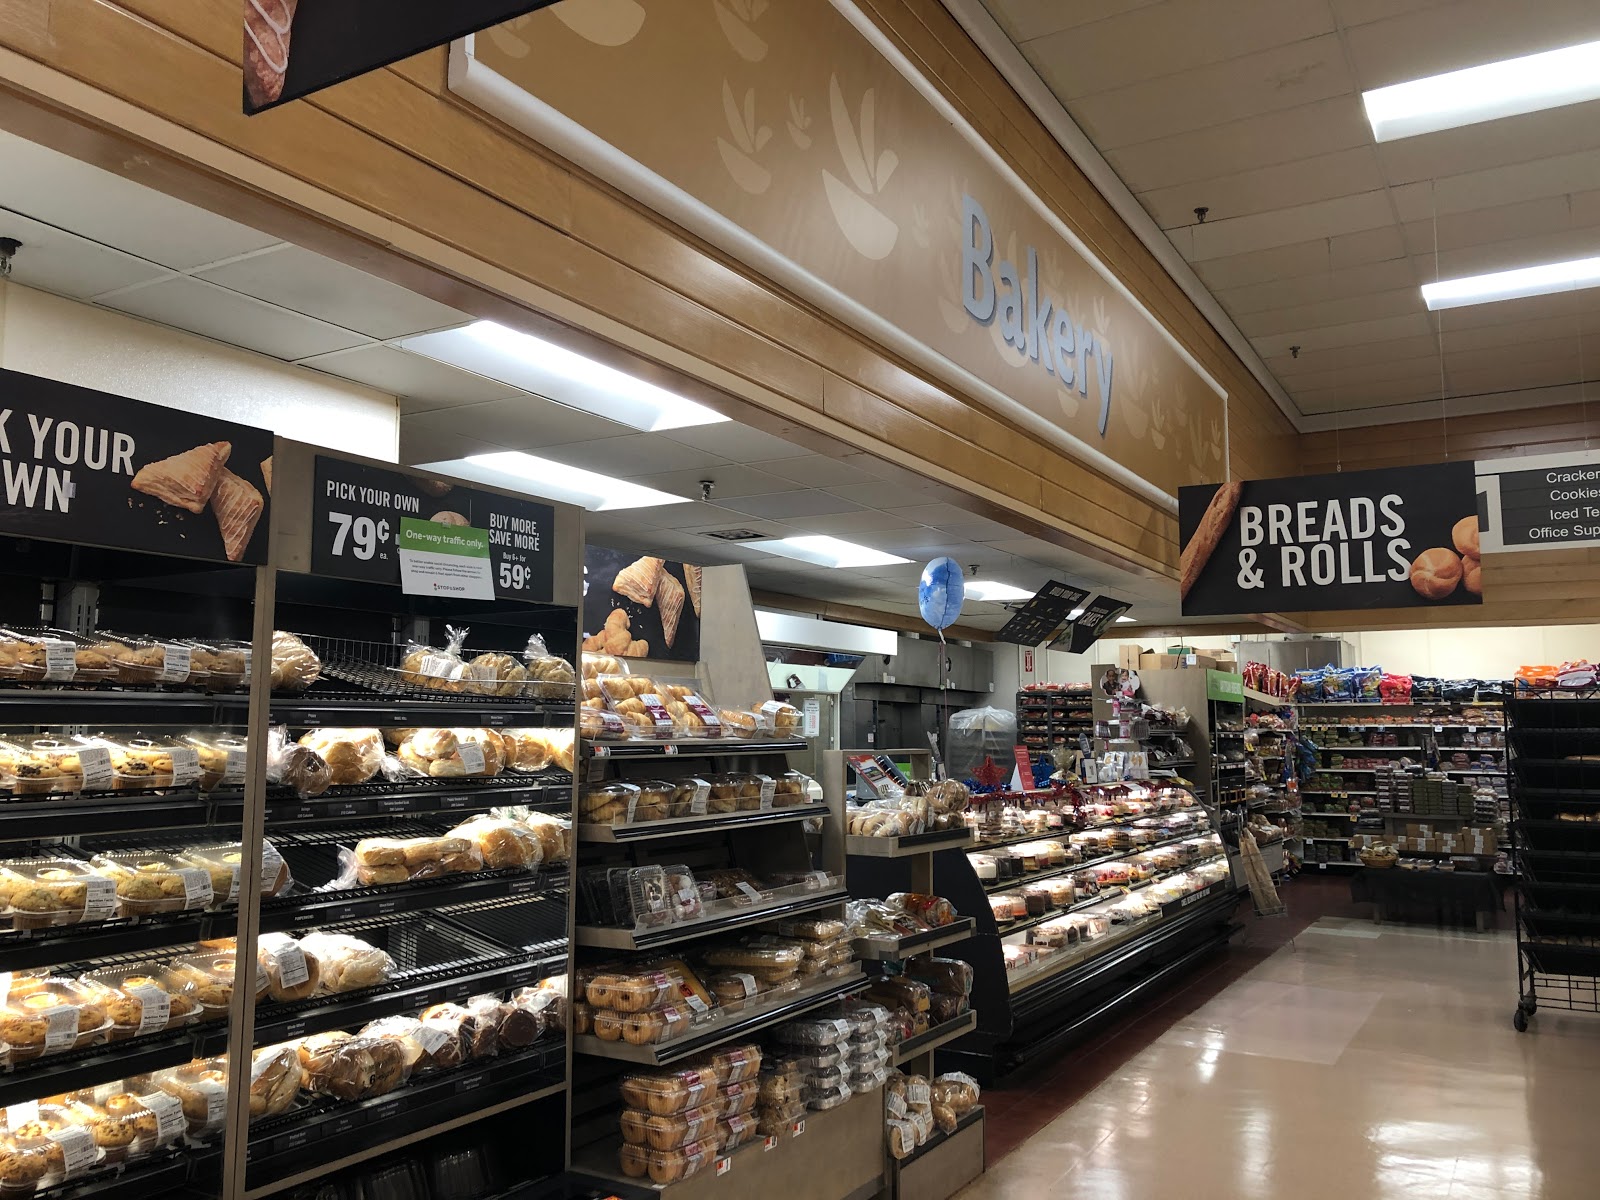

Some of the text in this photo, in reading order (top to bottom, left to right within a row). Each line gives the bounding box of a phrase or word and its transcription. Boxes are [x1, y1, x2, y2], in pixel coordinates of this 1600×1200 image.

[962, 193, 1114, 438] Bakery
[27, 413, 136, 476] YOUR
[326, 480, 420, 513] PICK YOUR OWN
[1550, 488, 1600, 501] Cookie
[490, 513, 540, 537] BUY MORE,
[1240, 494, 1406, 547] BREADS
[1550, 507, 1579, 520] Iced
[329, 511, 390, 560] 79¢
[405, 529, 484, 550] One-way traffic only.
[489, 529, 540, 551] SAVE MORE
[1529, 527, 1569, 539] Office
[380, 552, 389, 560] ea.
[503, 552, 512, 561] Buy
[519, 554, 527, 562] for
[1237, 538, 1411, 590] & ROLLS
[499, 562, 532, 590] 59¢
